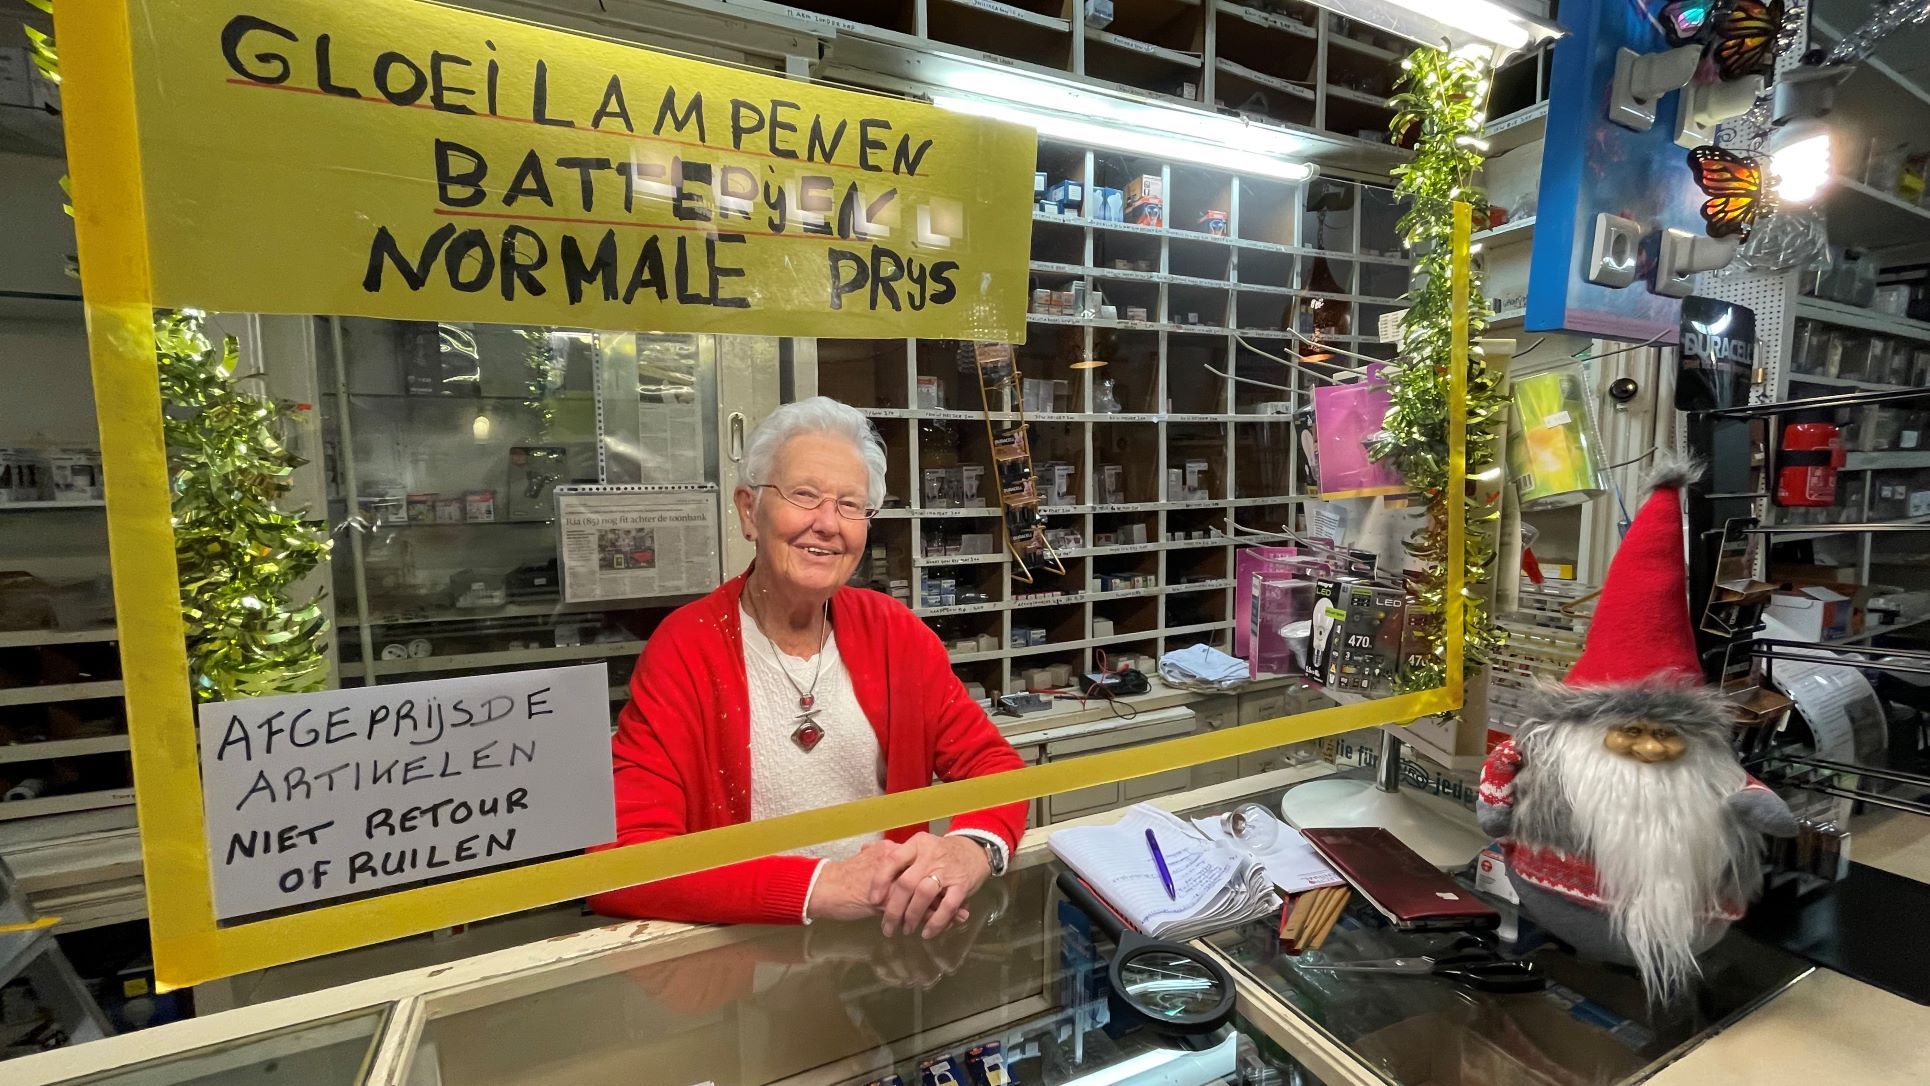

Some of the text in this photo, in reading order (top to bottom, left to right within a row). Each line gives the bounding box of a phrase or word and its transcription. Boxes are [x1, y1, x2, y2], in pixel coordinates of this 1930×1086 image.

[860, 119, 933, 177] EN
[362, 223, 751, 309] NORMALE
[601, 516, 618, 526] nog
[619, 514, 628, 524] fit
[629, 513, 656, 524] achter
[657, 513, 667, 522] de
[668, 512, 707, 523] toonbank
[1316, 587, 1332, 597] LED
[1376, 597, 1402, 608] LED
[1348, 634, 1370, 648] 470
[236, 741, 536, 812] ARTIKELEN
[225, 787, 529, 866] NIET RETOUR
[278, 828, 517, 894] OF RUILEN
